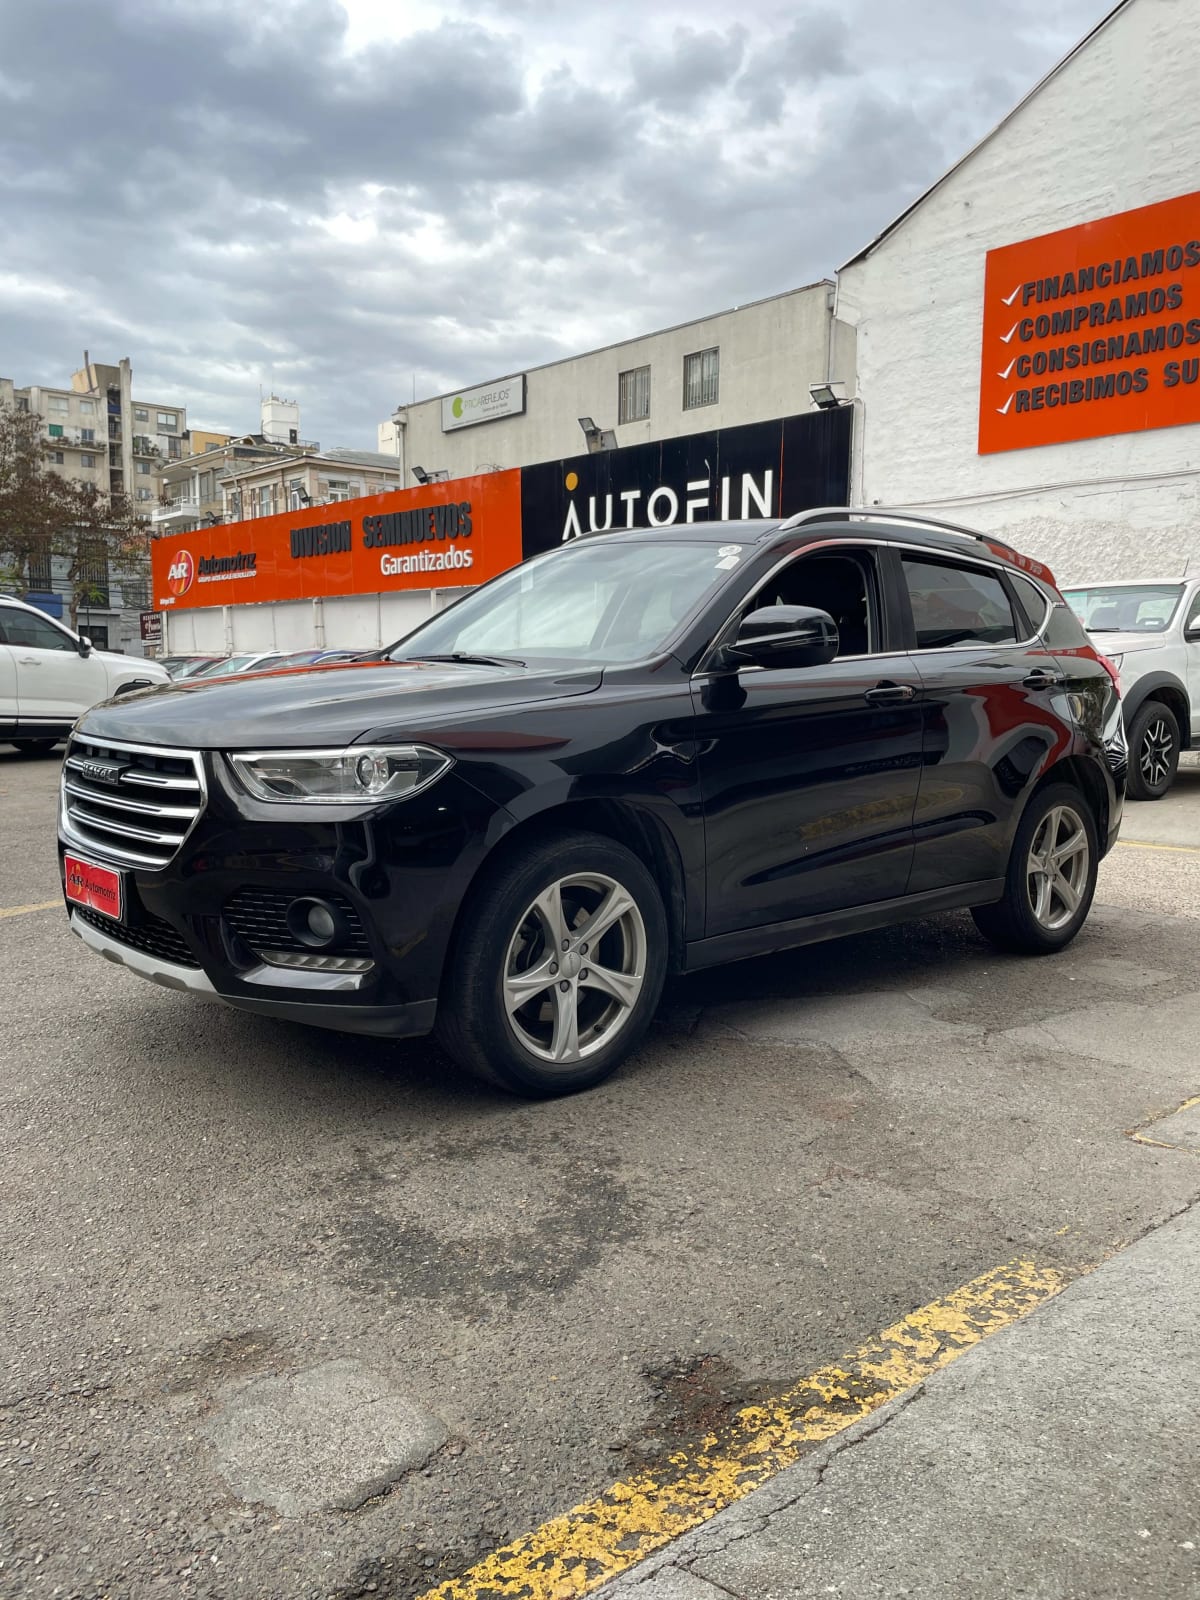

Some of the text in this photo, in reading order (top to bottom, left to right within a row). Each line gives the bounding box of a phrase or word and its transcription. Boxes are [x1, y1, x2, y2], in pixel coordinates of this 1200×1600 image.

[1022, 240, 1200, 306] FINANCIAMOS
[1019, 283, 1183, 342] COMPRAMOS
[1016, 318, 1200, 378] CONSIGNAMOS
[1015, 357, 1200, 413] RECIBIMOS SU
[290, 501, 472, 559] DIVISION SEMINUEVOS
[562, 469, 773, 541] AUTOFIN
[168, 562, 189, 581] AR
[197, 551, 257, 576] Automotriz
[380, 545, 473, 576] Garantizados
[85, 879, 117, 901] Automotriz
